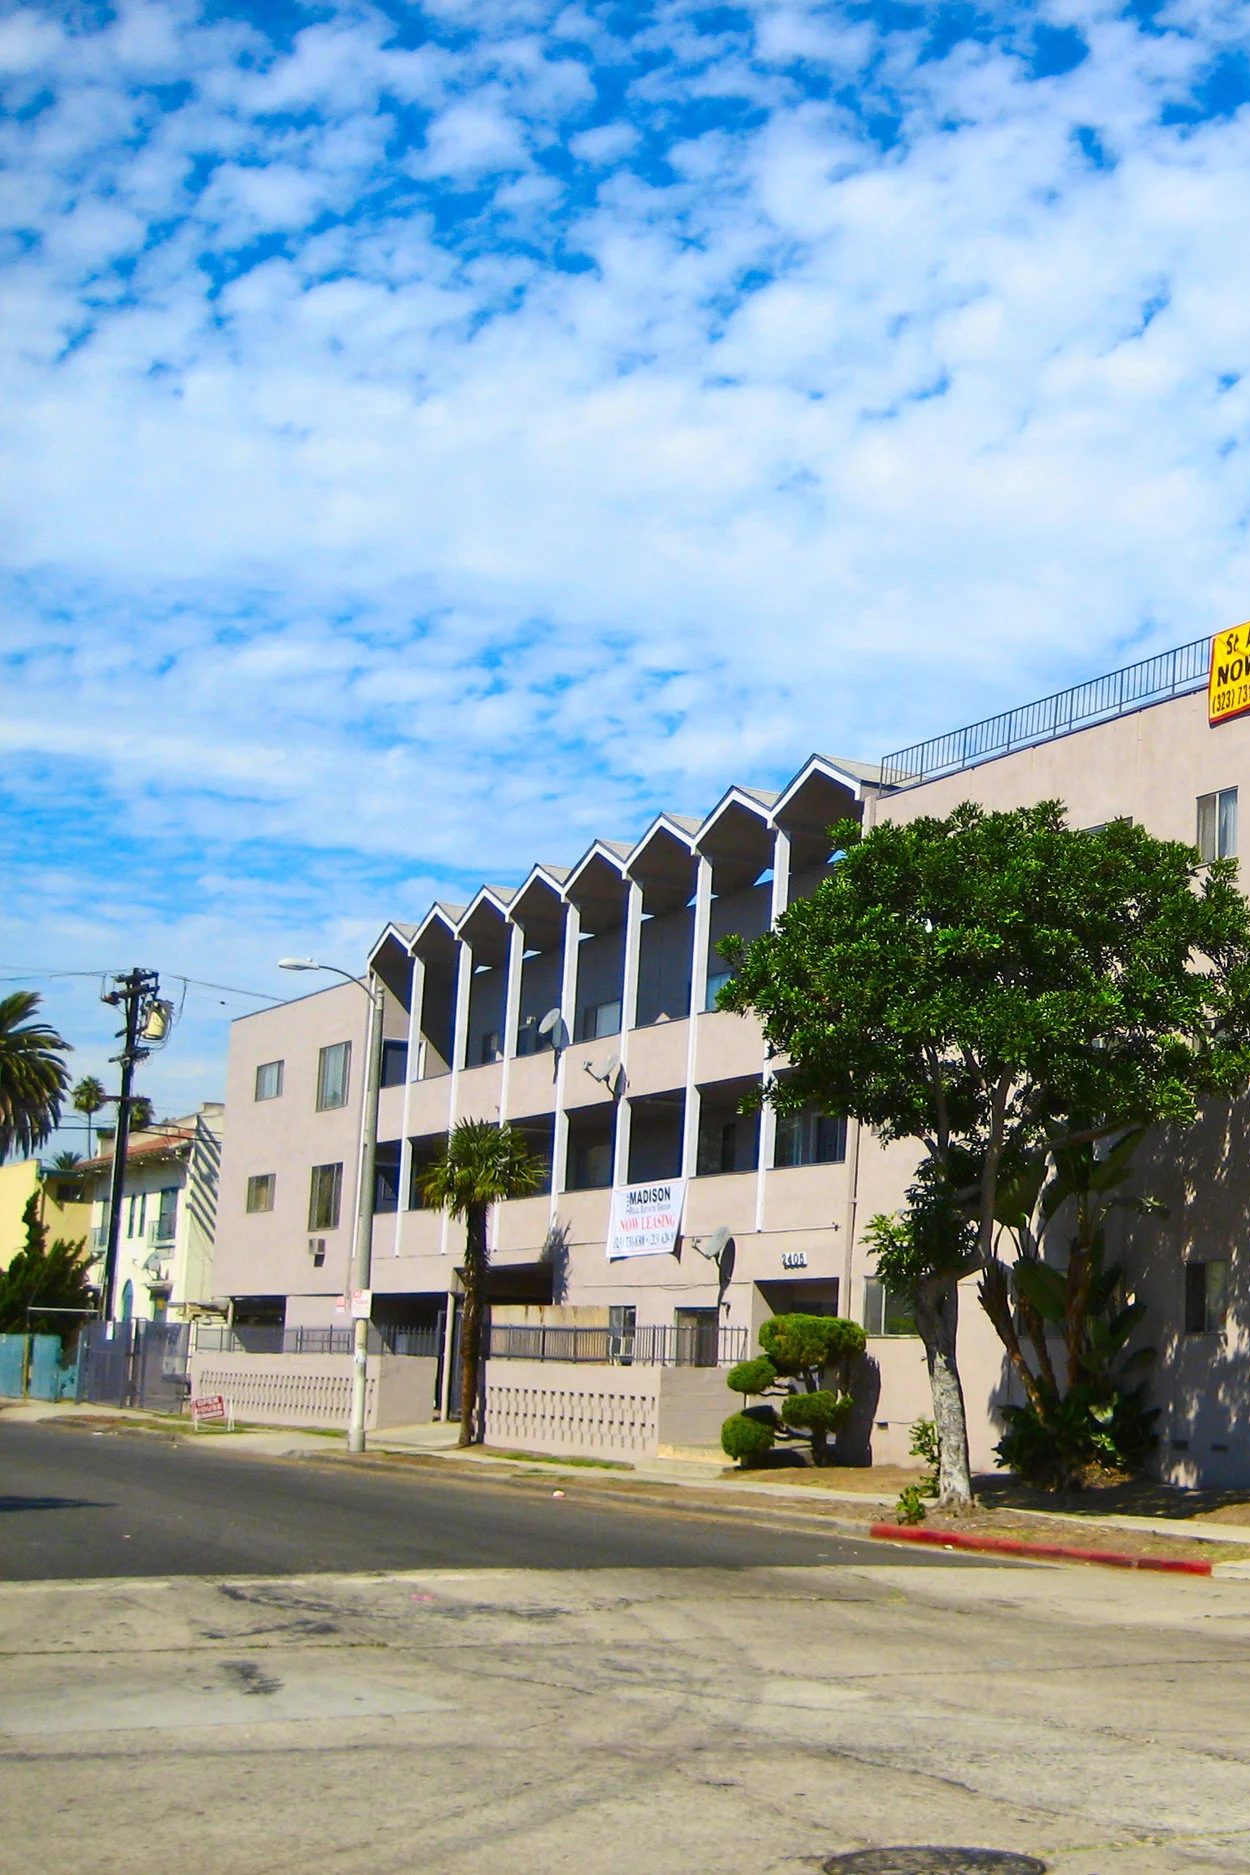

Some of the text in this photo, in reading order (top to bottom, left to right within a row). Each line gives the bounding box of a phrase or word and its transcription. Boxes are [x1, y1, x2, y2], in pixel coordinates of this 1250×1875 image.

[1212, 690, 1235, 714] (323)
[629, 1187, 671, 1205] MADISON
[620, 1214, 675, 1232] NOW LEASING
[782, 1253, 805, 1267] 2405
